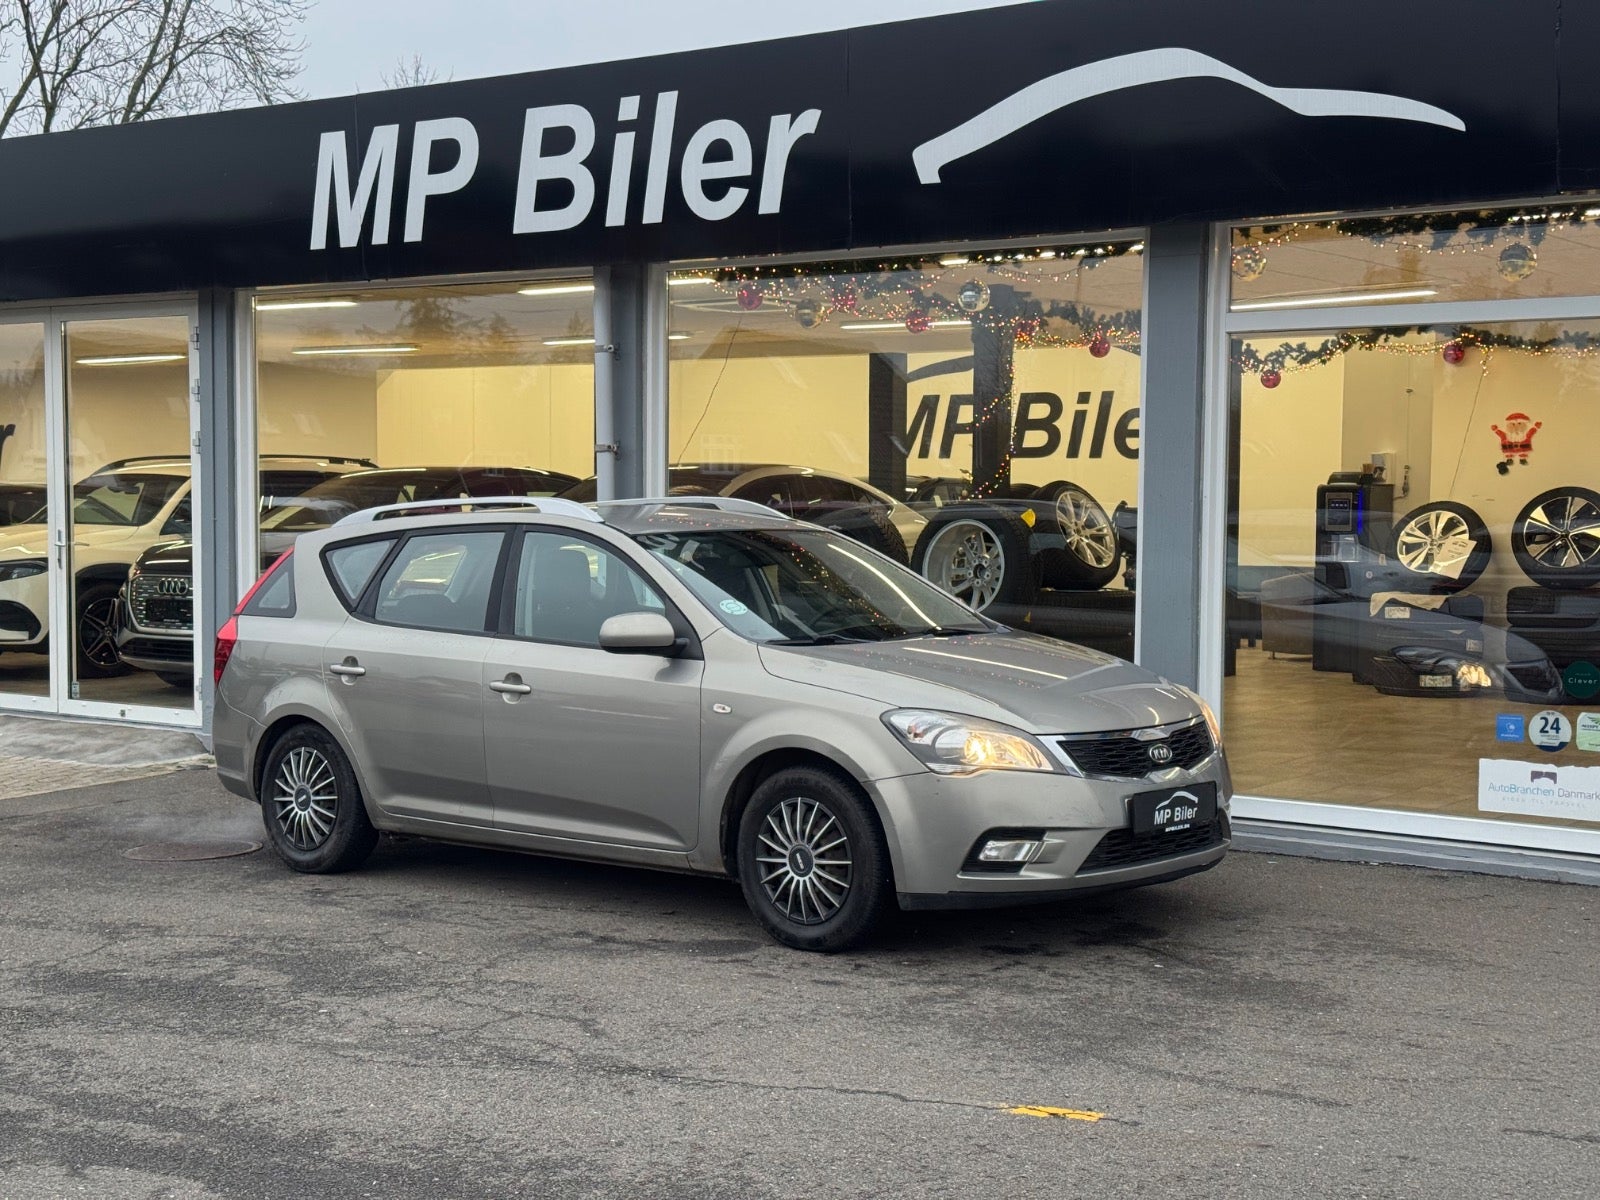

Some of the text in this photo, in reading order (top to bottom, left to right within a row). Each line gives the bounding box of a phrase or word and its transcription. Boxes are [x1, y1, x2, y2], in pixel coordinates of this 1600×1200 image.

[309, 90, 822, 250] MP Biler
[1539, 716, 1562, 735] 24
[1488, 782, 1600, 801] AutoBranchen Danmark
[1154, 805, 1198, 825] MP Biler
